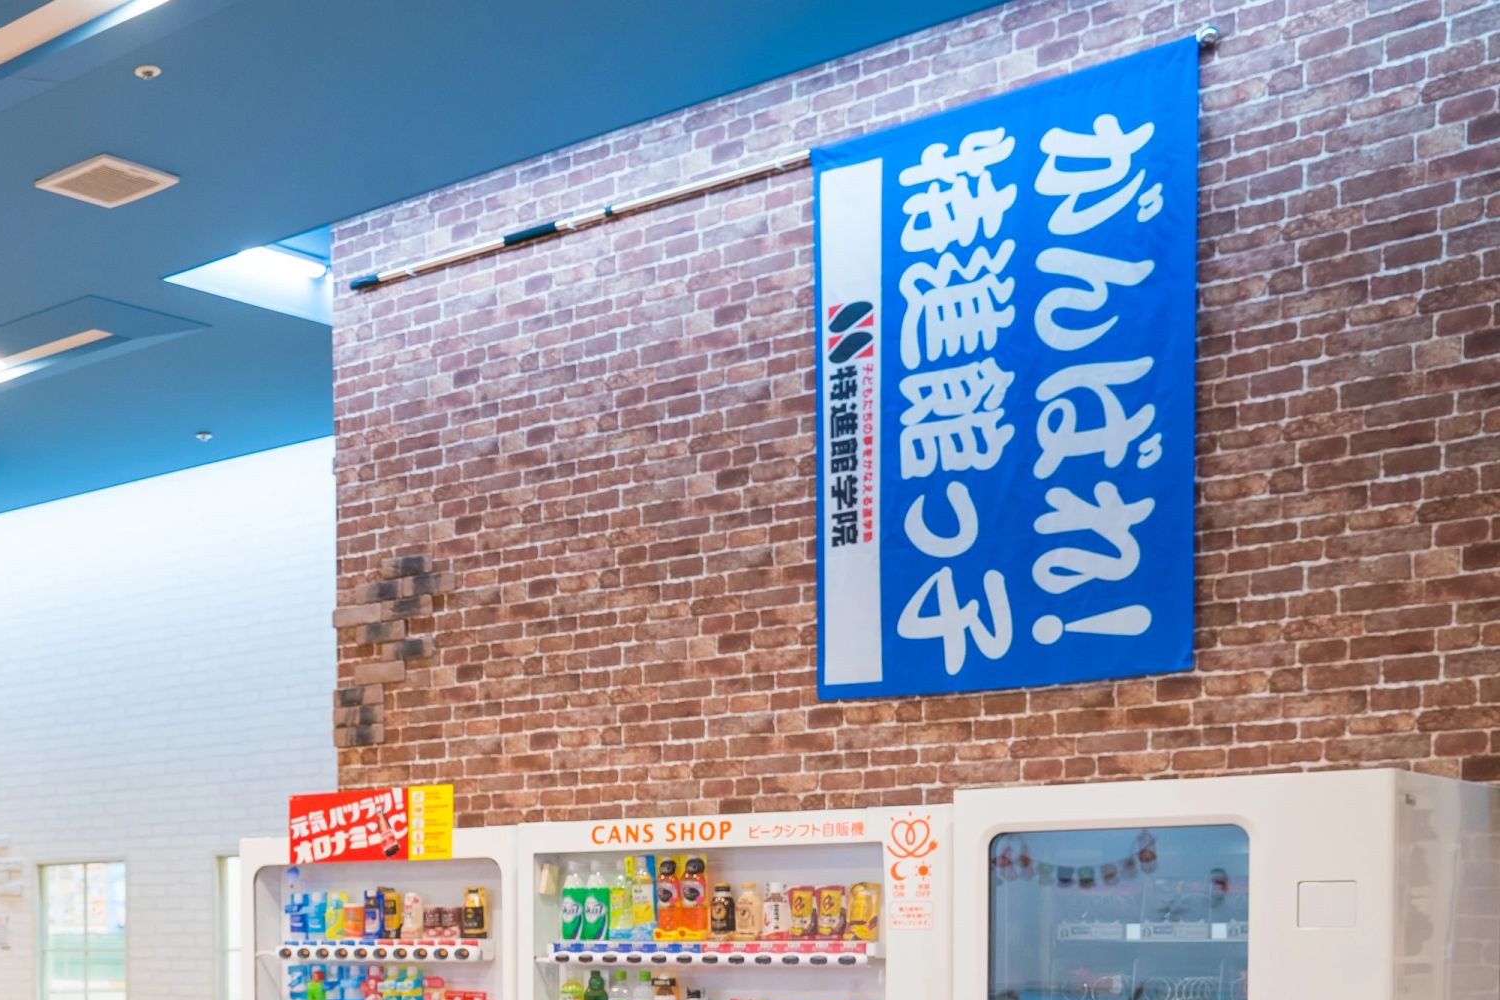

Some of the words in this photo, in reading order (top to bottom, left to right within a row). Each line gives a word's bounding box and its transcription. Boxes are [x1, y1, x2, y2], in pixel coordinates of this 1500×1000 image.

[897, 127, 1018, 675] 特進館っ子
[1033, 113, 1163, 646] がんばれ!
[829, 365, 859, 547] 特進館学院
[294, 813, 409, 864] オロナミンC
[591, 823, 654, 845] CANS
[666, 821, 732, 842] SHOP
[748, 822, 866, 841] ピークシフト自販機
